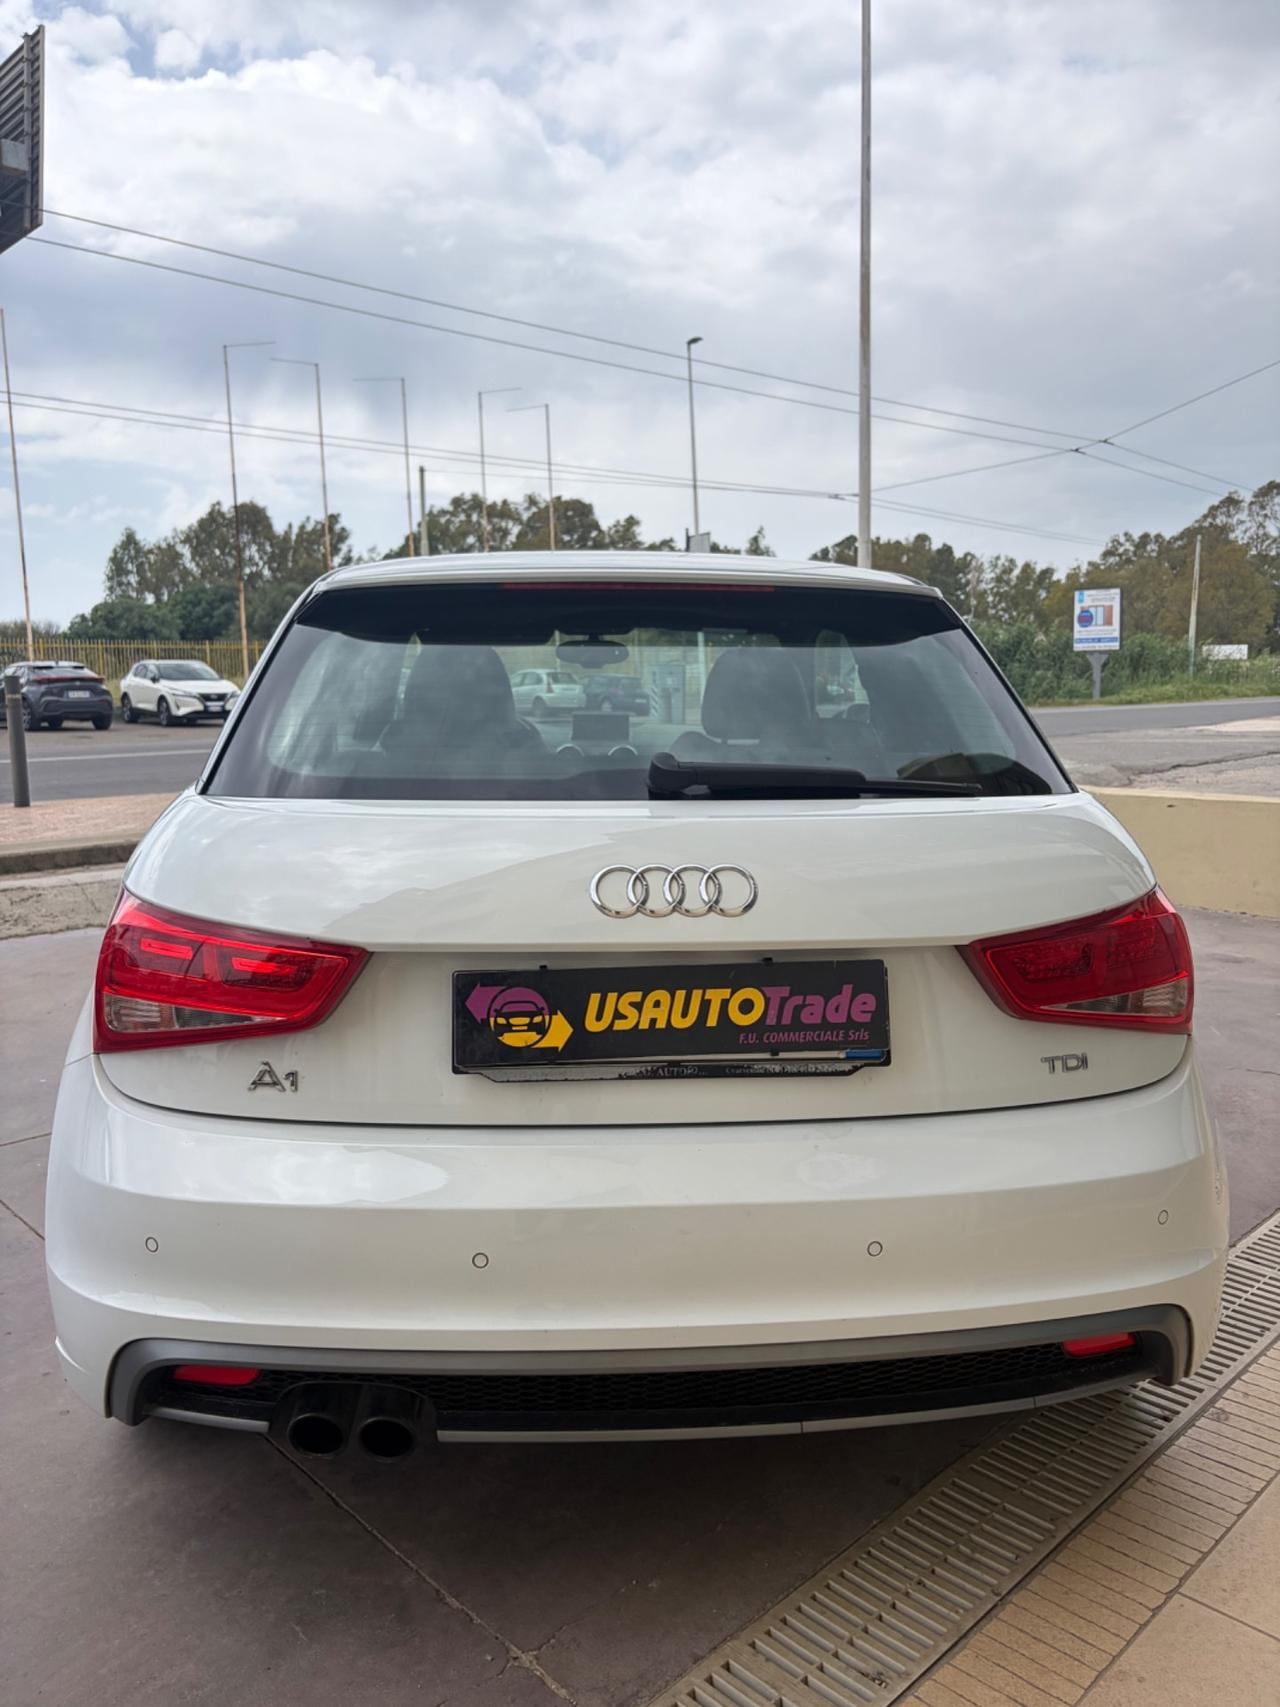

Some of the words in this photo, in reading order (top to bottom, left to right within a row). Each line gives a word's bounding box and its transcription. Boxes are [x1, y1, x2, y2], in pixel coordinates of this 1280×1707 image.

[739, 1032, 759, 1044] F.U.
[763, 1030, 845, 1043] COMMERCIALE
[847, 1028, 870, 1041] Srls
[1040, 1052, 1088, 1074] TDI
[247, 1061, 298, 1092] A1
